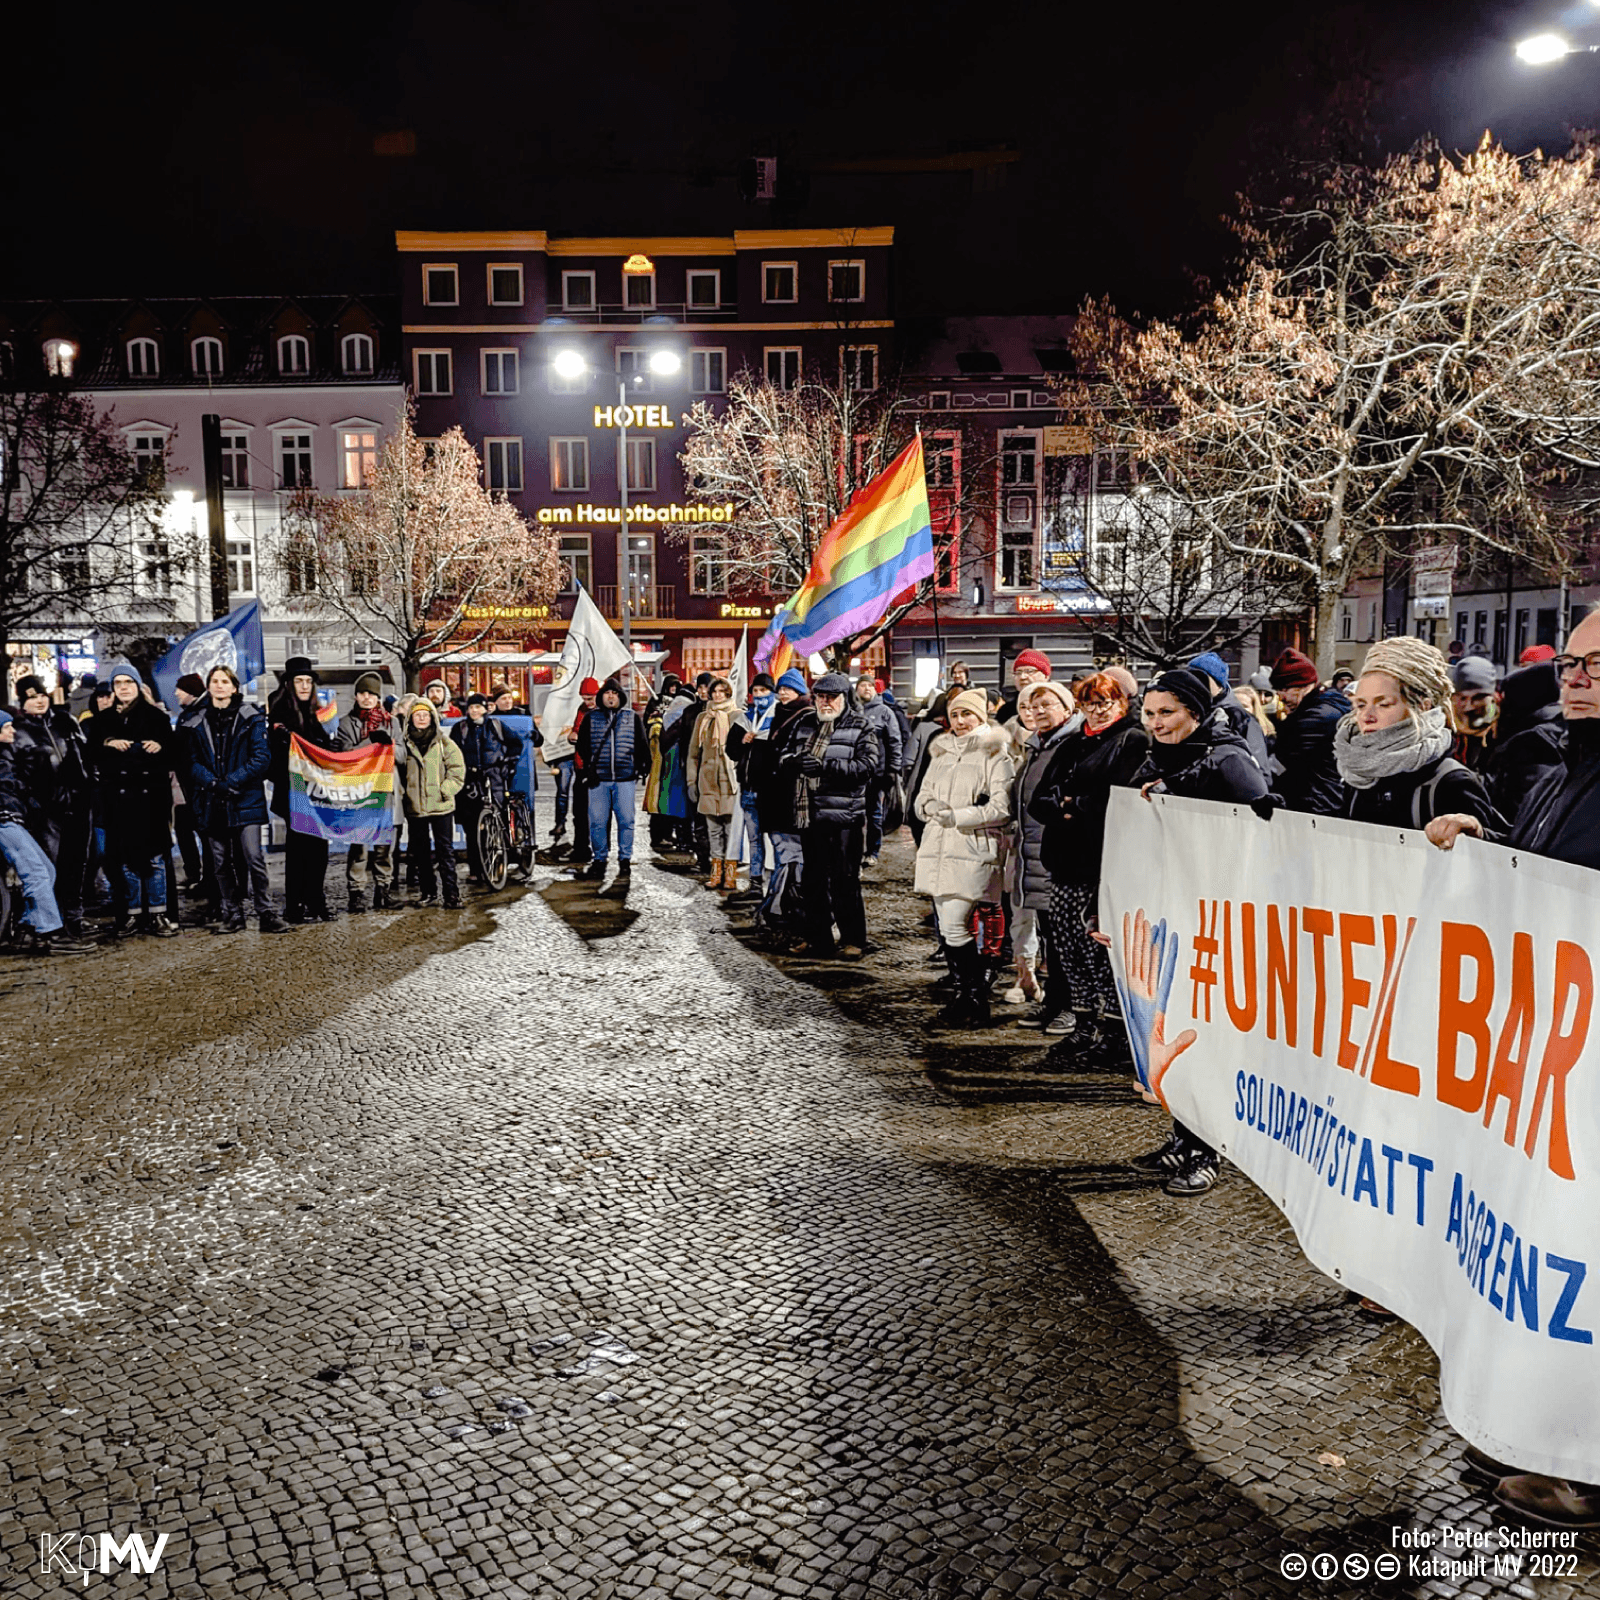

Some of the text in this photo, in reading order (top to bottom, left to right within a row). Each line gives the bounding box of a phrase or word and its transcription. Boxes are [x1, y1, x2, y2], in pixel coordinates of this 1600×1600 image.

[594, 405, 674, 428] HOTEL
[537, 507, 573, 523] am
[720, 603, 762, 617] Pizza
[1327, 1124, 1434, 1226] STATT
